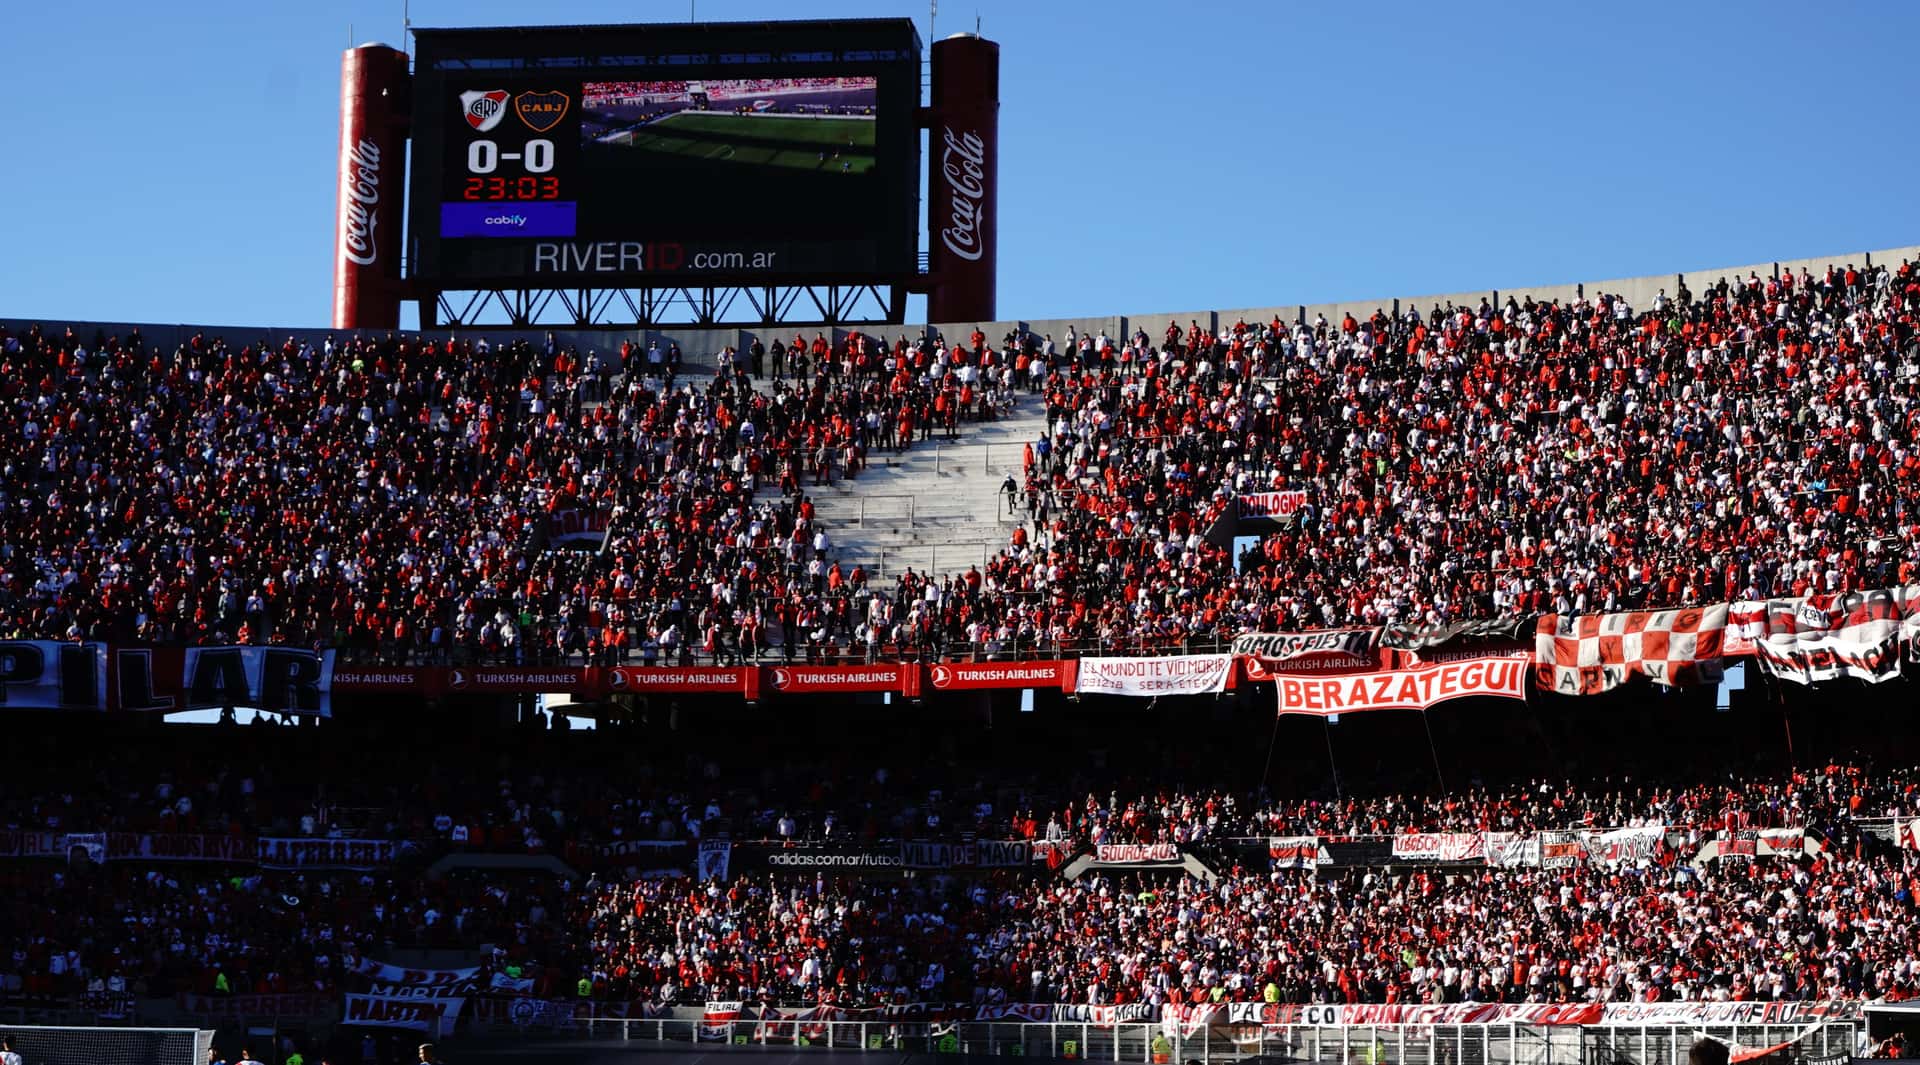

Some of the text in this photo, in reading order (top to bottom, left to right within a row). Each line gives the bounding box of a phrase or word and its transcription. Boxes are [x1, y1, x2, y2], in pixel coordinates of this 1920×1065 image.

[522, 103, 562, 112] CABJ
[468, 139, 555, 174] 0-0
[464, 177, 559, 200] 23:03
[943, 126, 985, 261] Coca-Cola
[485, 215, 527, 226] cabify
[1084, 661, 1096, 673] EL
[1101, 662, 1145, 676] MUNDO
[1148, 662, 1161, 676] TE
[1188, 658, 1226, 673] MORIR
[1274, 657, 1372, 671] TURKISH AIRLINES
[0, 642, 322, 714] PILAR
[333, 671, 415, 684] KISH AIRLINES
[477, 671, 576, 684] TURKISH AIRLINES
[636, 673, 738, 685] TURKISH AIRLINES
[797, 669, 897, 685] TURKISH AIRLINES
[957, 667, 1055, 681] TURKISH AIRLINES
[1283, 663, 1517, 708] BERAZATEGUI
[903, 843, 951, 866] VILLA
[953, 845, 974, 864] DE
[978, 843, 1025, 864] MAYO
[708, 1003, 737, 1011] FILIAL
[1051, 1004, 1092, 1022] VILLA
